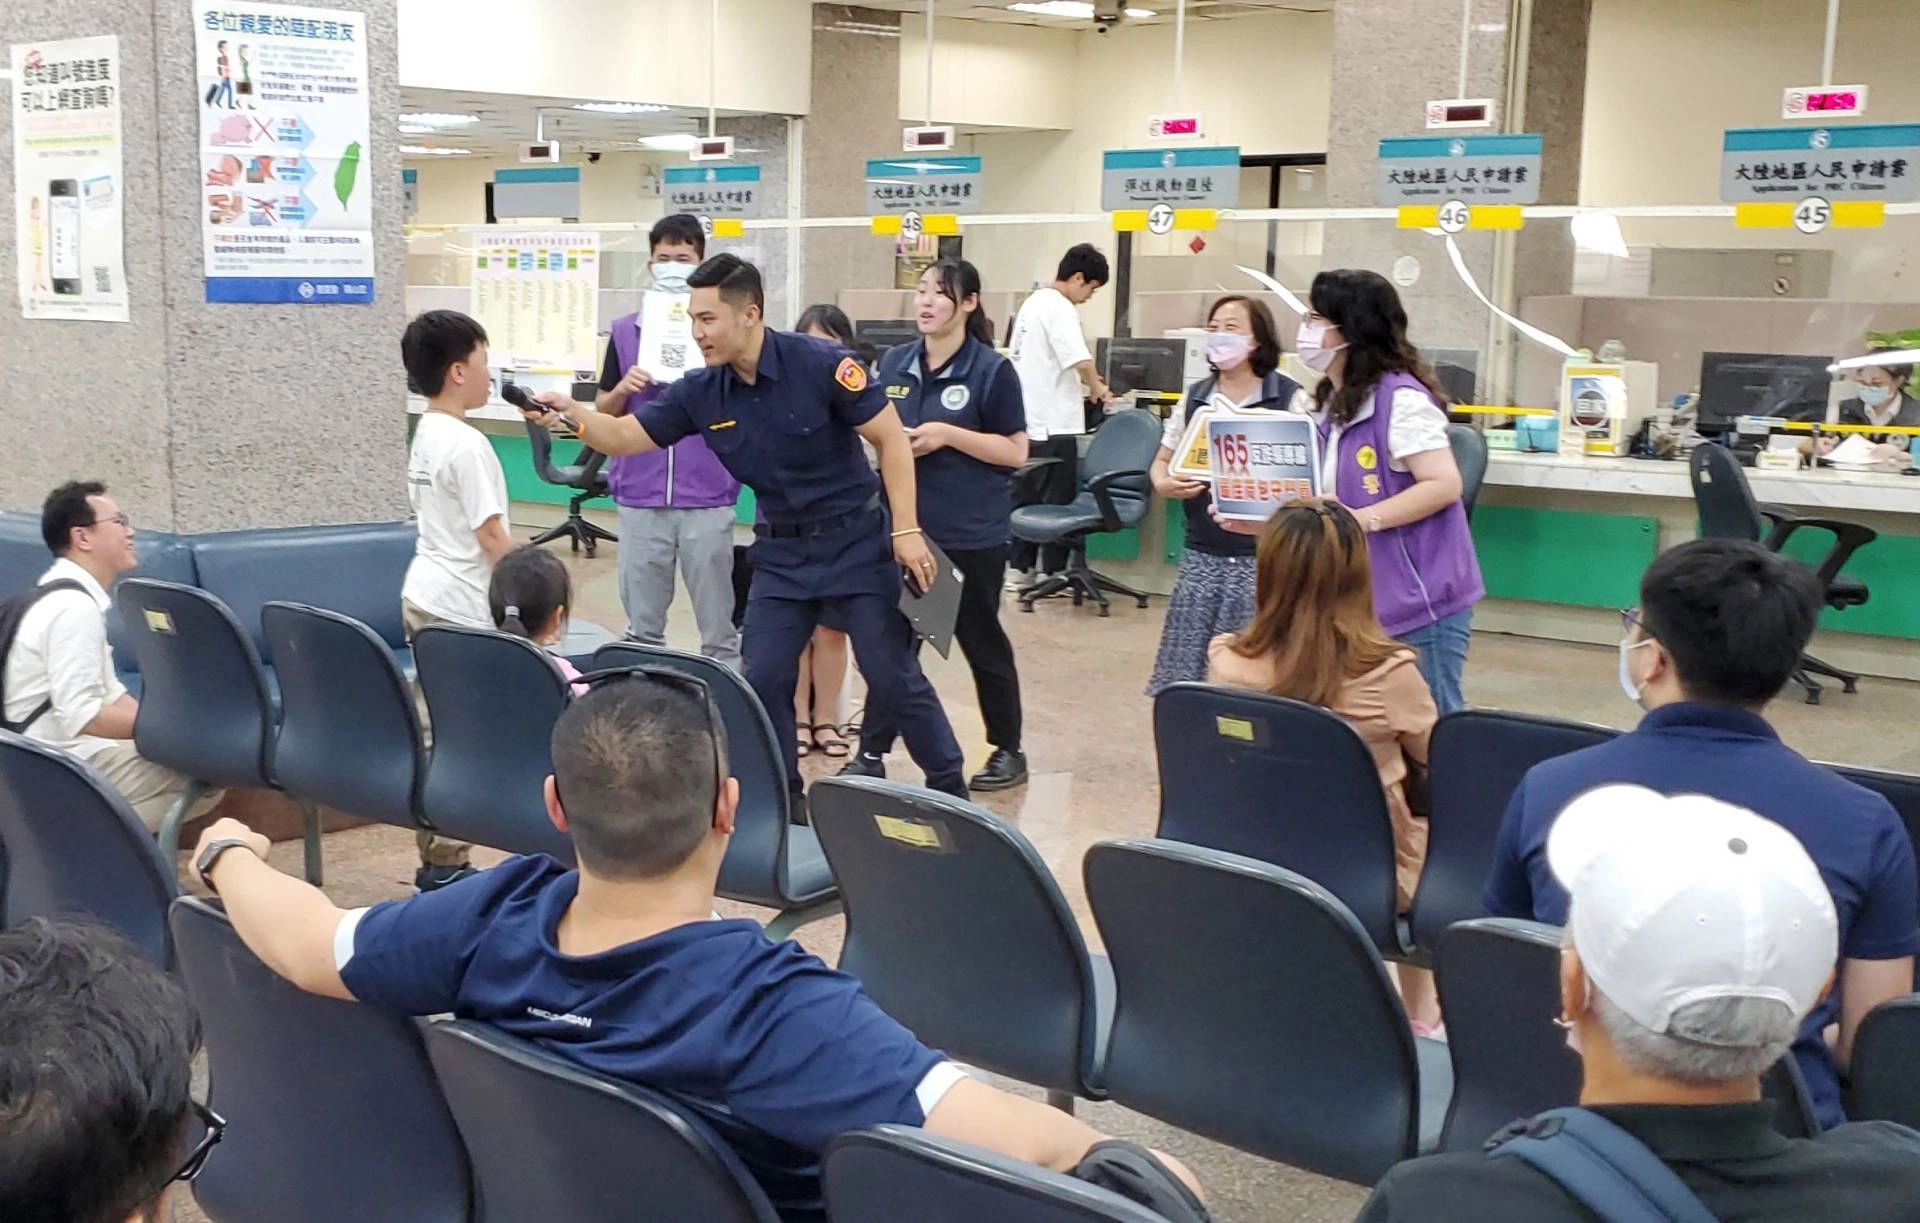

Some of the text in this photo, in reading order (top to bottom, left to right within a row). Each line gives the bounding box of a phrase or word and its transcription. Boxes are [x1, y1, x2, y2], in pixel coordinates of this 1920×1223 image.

[203, 11, 355, 41] 各位親愛的陸配朋友
[1388, 166, 1528, 184] 大陸地區人民申請案
[1735, 159, 1909, 180] 大陸地區人民申請案
[1149, 211, 1174, 226] 47
[1440, 208, 1468, 225] 46
[1796, 206, 1830, 224] 45
[902, 217, 922, 232] 48
